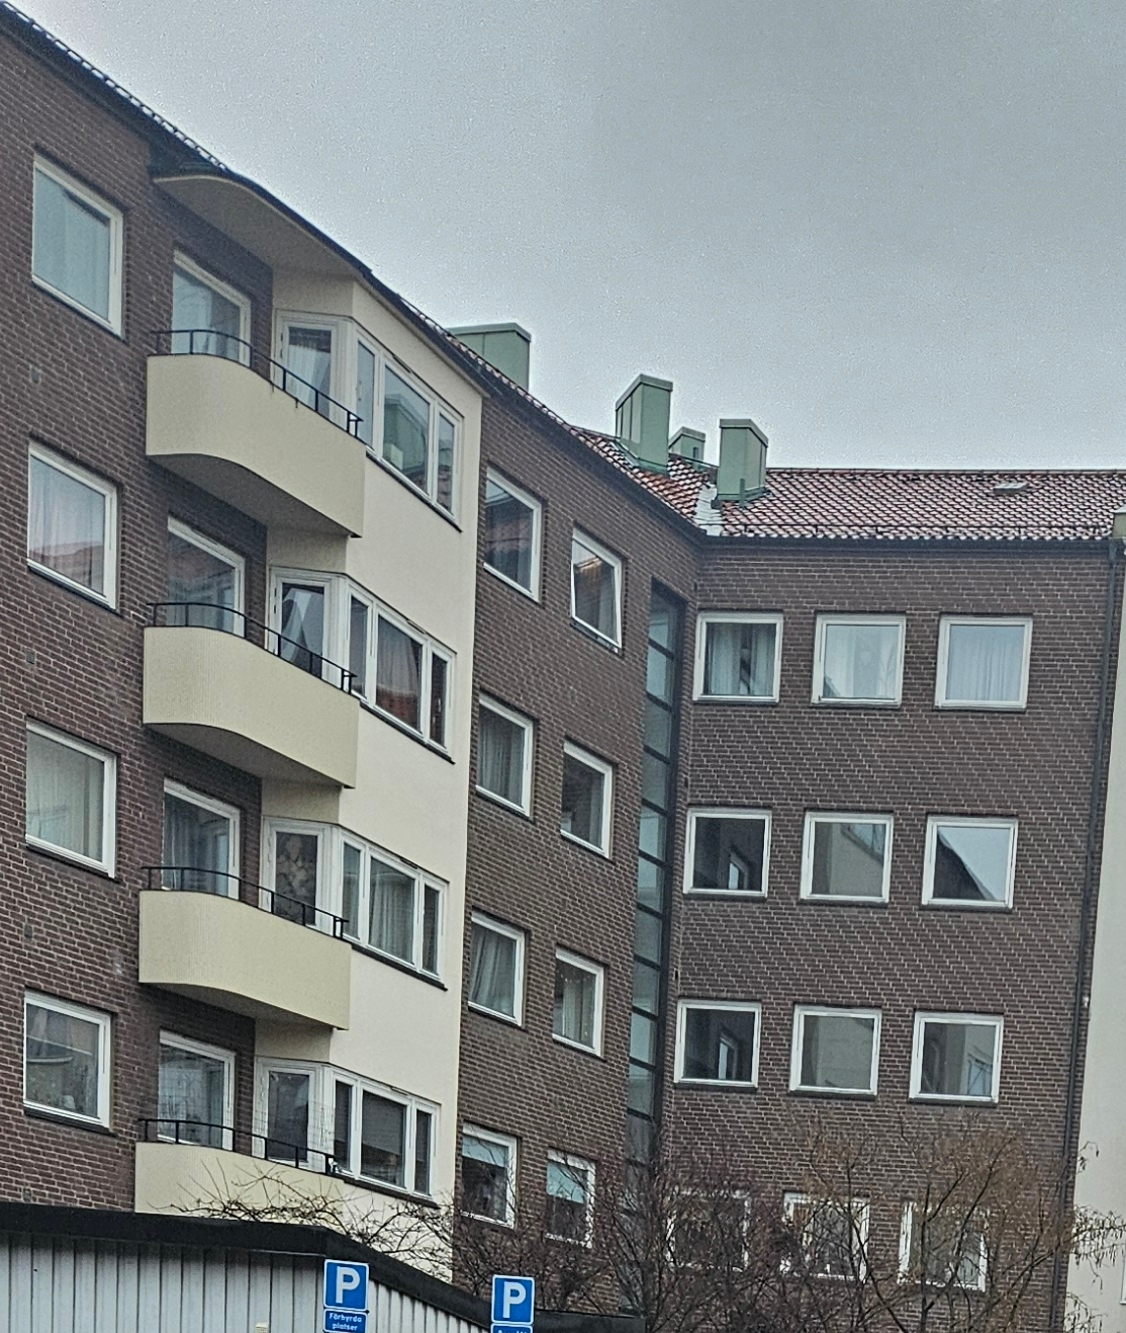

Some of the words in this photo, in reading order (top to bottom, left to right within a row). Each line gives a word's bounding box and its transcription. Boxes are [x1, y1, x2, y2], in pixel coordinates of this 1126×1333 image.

[335, 1265, 361, 1304] P
[502, 1281, 526, 1318] P
[331, 1322, 358, 1331] platser
